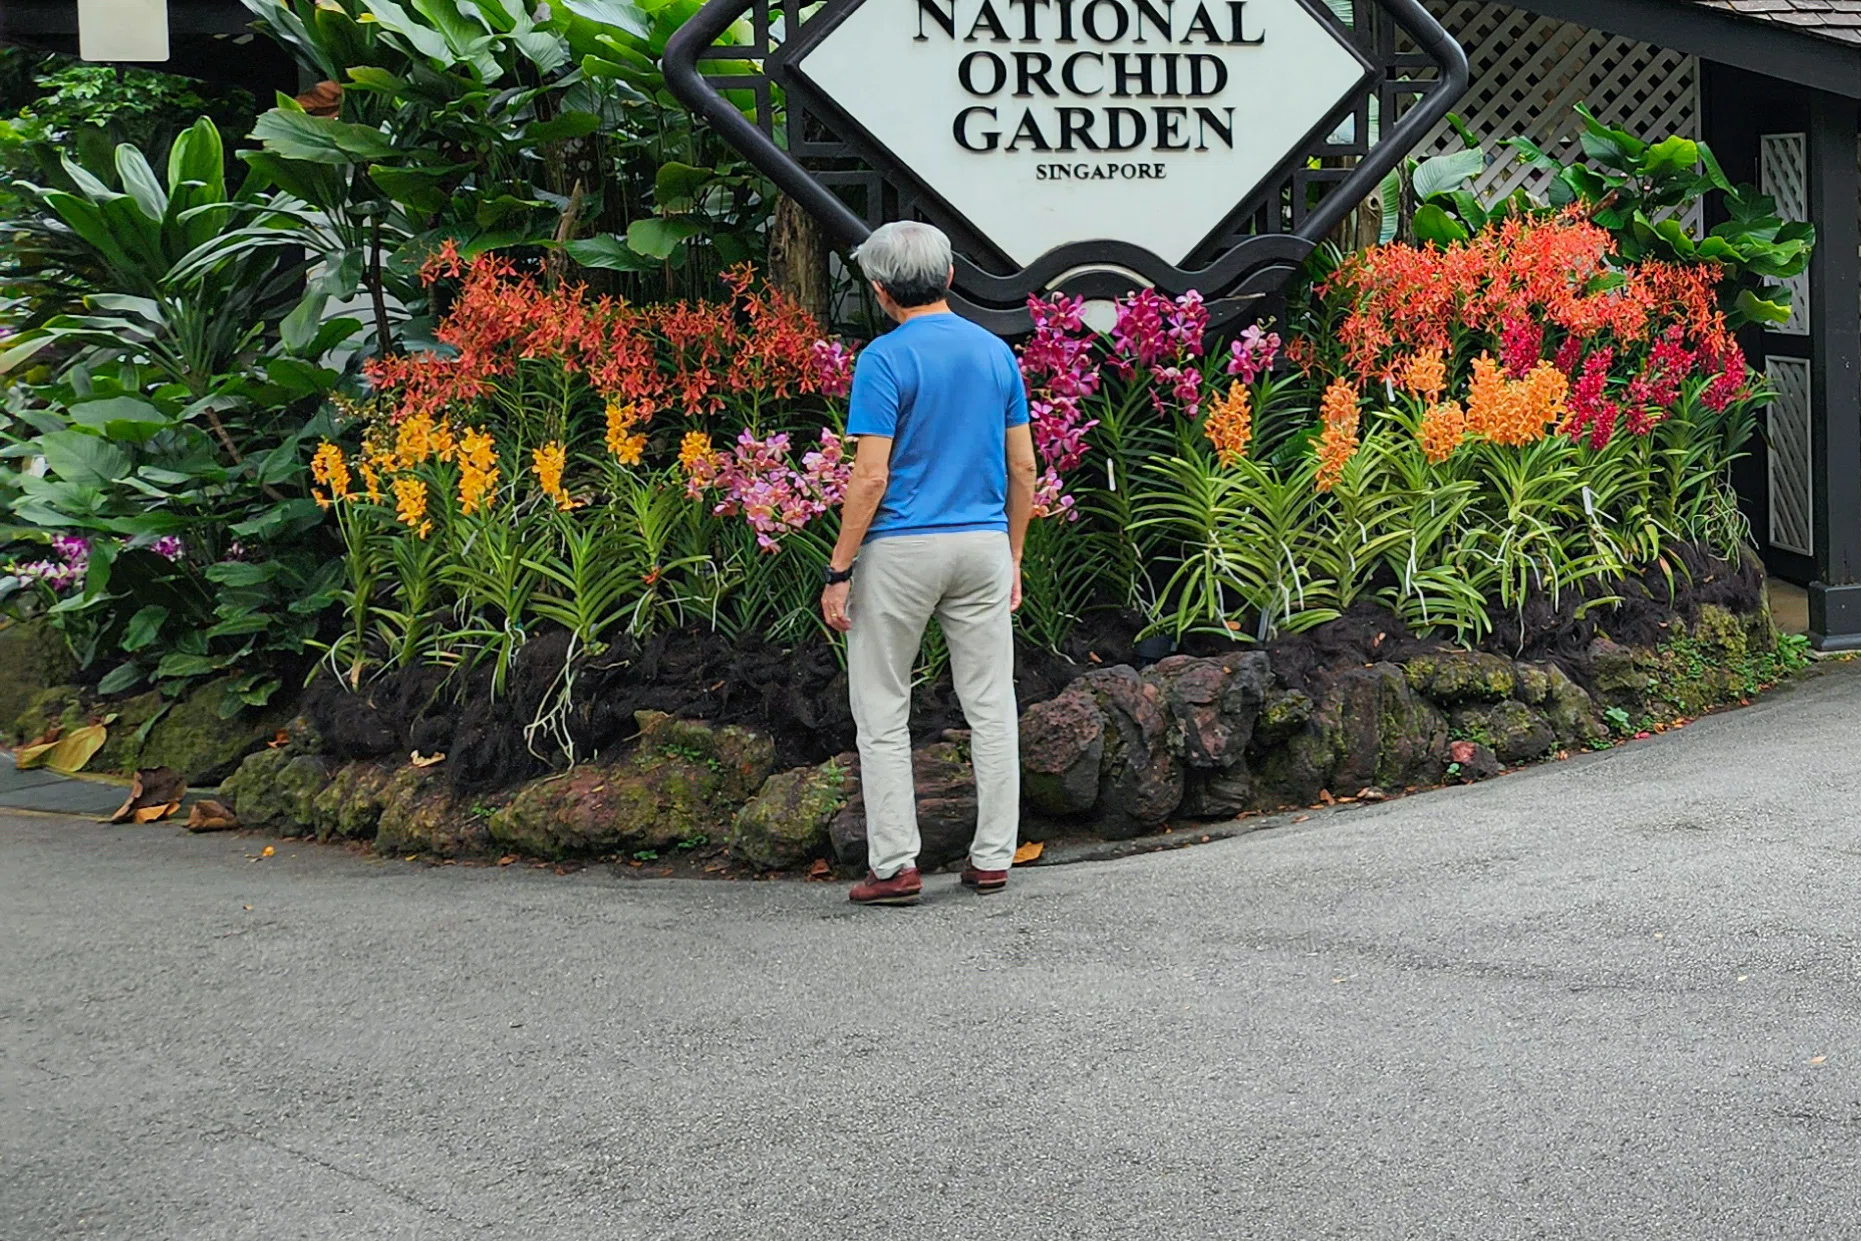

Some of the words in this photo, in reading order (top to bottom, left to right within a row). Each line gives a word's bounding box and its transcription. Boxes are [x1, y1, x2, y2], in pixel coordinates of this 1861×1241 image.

[957, 50, 1229, 99] ORCHID
[952, 105, 1237, 154] GARDEN
[1035, 162, 1167, 181] SINGAPORE
